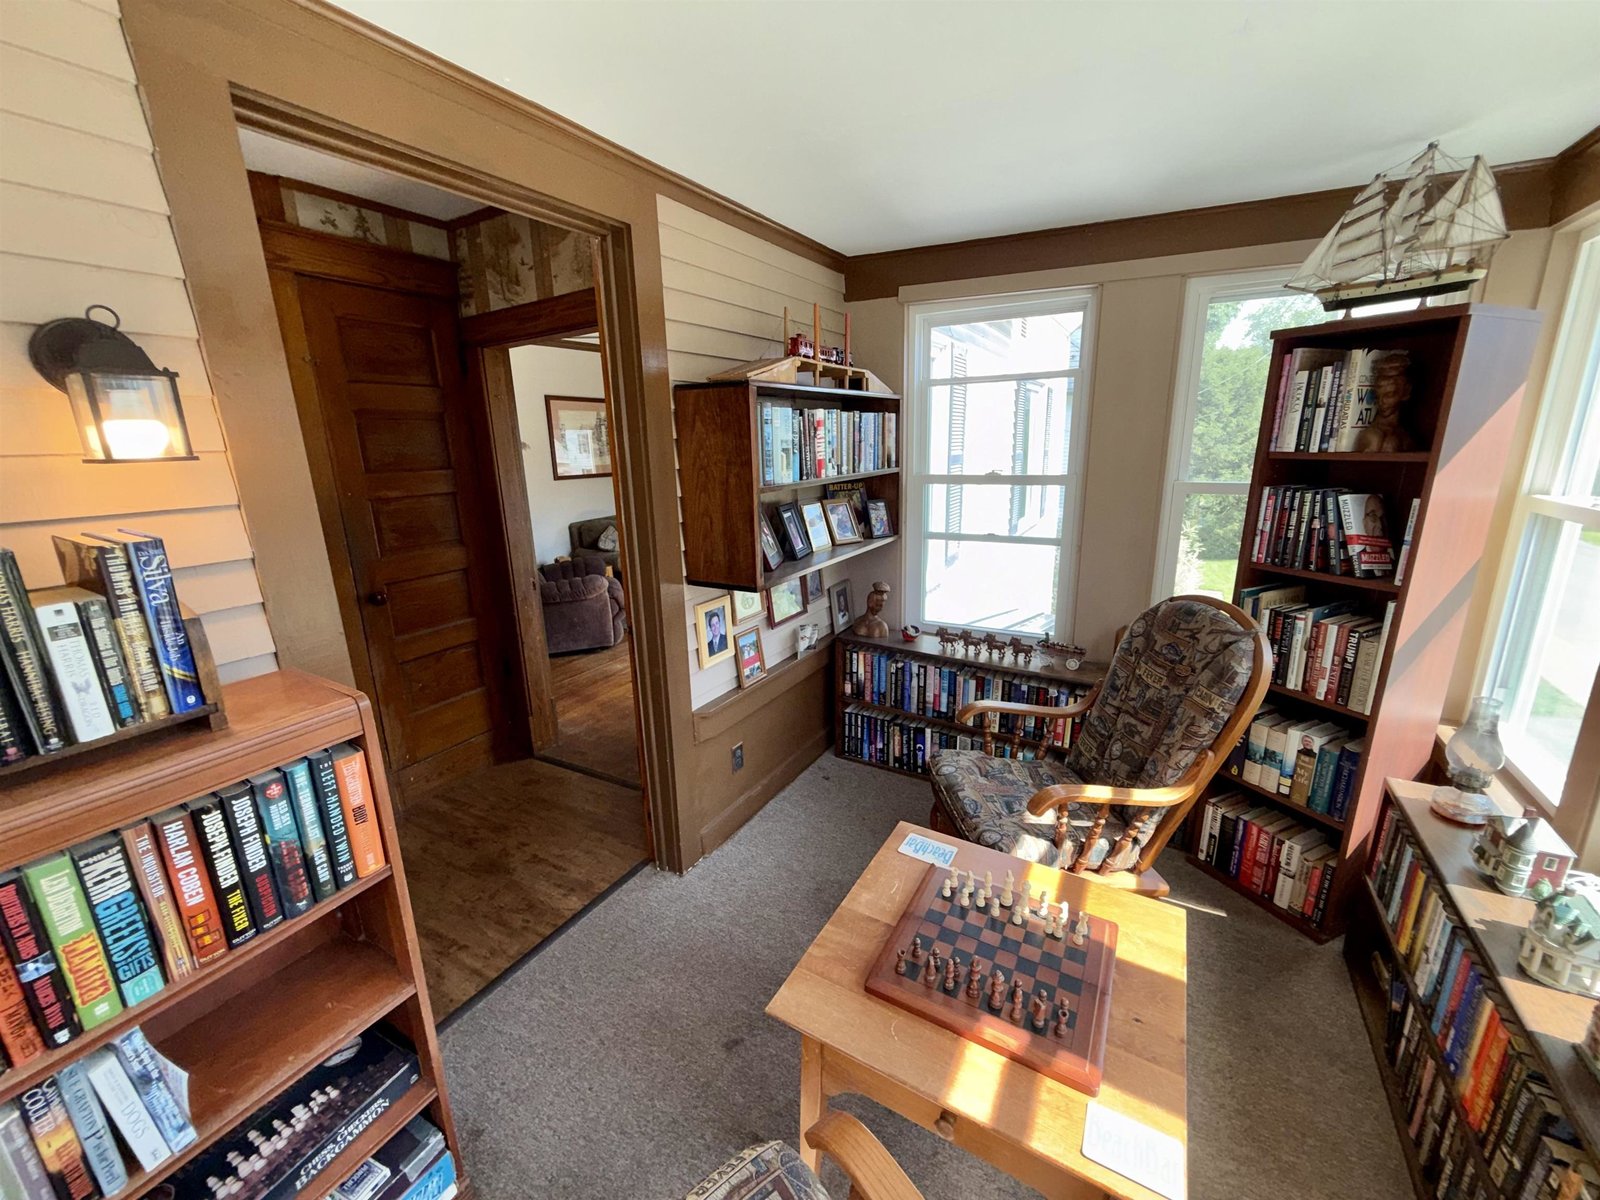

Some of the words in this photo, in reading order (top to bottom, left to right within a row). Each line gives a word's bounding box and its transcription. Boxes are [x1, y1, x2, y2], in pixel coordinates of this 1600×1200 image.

[1341, 499, 1352, 530] MUZZLED
[1361, 553, 1391, 562] MUZZLED
[139, 553, 171, 606] Silva
[5, 606, 25, 644] HARRIS
[175, 632, 185, 645] An
[1344, 632, 1358, 662] TRUMP
[16, 648, 45, 701] HANNIBAL
[34, 700, 57, 736] RISING
[294, 771, 308, 790] THE
[231, 795, 257, 836] JOSEPH
[299, 789, 317, 825] TERMINAL
[321, 769, 345, 836] LEFT-HANDED
[335, 835, 350, 863] TWIN
[352, 804, 368, 826] BODY
[134, 833, 151, 853] THE
[163, 820, 194, 867] HARLAN
[201, 809, 229, 850] JOSEPH
[306, 824, 320, 840] LIST
[79, 846, 121, 867] PHILIP
[213, 848, 239, 888] FINDER
[242, 833, 266, 870] FINDER
[313, 846, 327, 865] JACK
[40, 869, 70, 894] LEN
[81, 853, 131, 905] KERR
[139, 851, 166, 897] INQUISITOR
[176, 866, 205, 906] COBEN
[317, 863, 330, 883] CARR
[48, 886, 84, 937] DEIGHTON
[227, 888, 242, 907] THE
[255, 872, 276, 916] SUSPICION
[95, 891, 150, 962] GREEKS
[230, 905, 249, 931] FIXER
[117, 955, 155, 982] GIFTS
[22, 1088, 56, 1137] COULTER
[73, 1087, 98, 1131] GRAFTON
[121, 1100, 149, 1139] DOGS
[84, 1125, 106, 1140] P
[294, 1097, 390, 1190] BACKGAMMON
[299, 1141, 336, 1175] CHESS,
[334, 1096, 385, 1142] CHECKERS,
